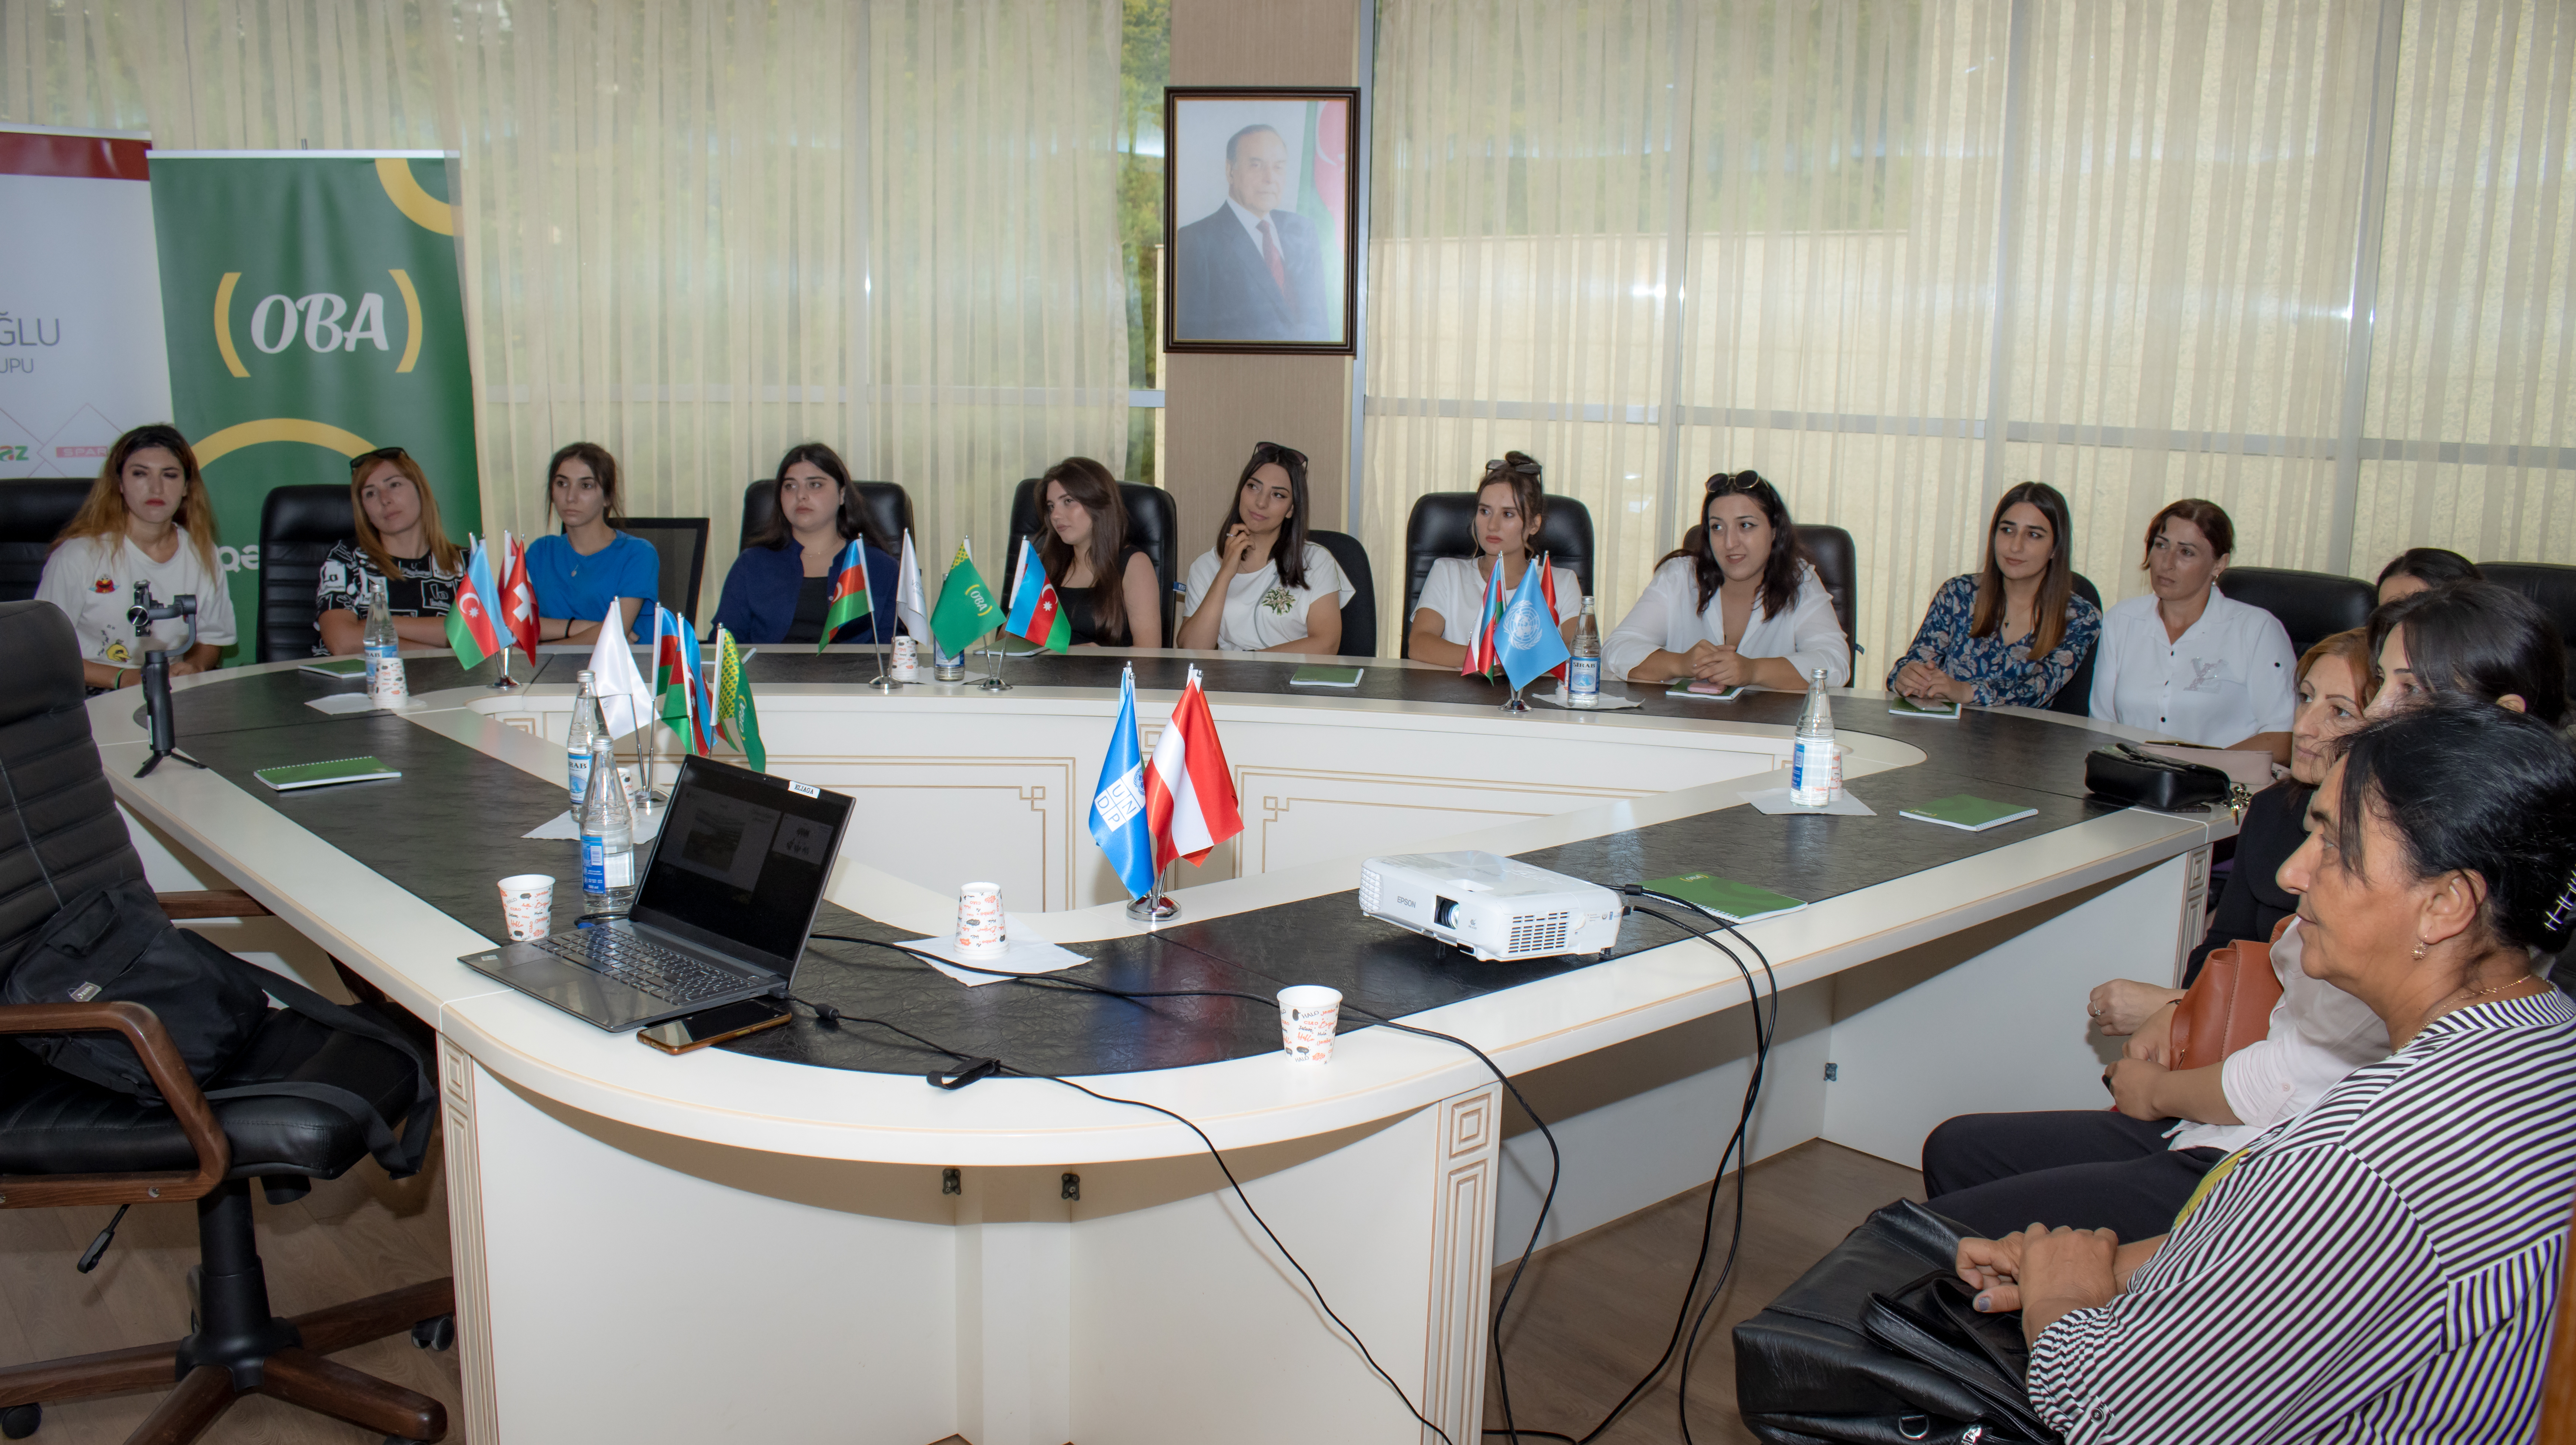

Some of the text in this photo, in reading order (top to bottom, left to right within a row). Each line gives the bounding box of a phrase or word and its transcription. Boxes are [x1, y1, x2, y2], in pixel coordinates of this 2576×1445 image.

[63, 447, 107, 457] SPAR
[794, 784, 814, 795] ELIAGA
[1397, 896, 1416, 908] EPSON
[1301, 1010, 1319, 1019] HALO
